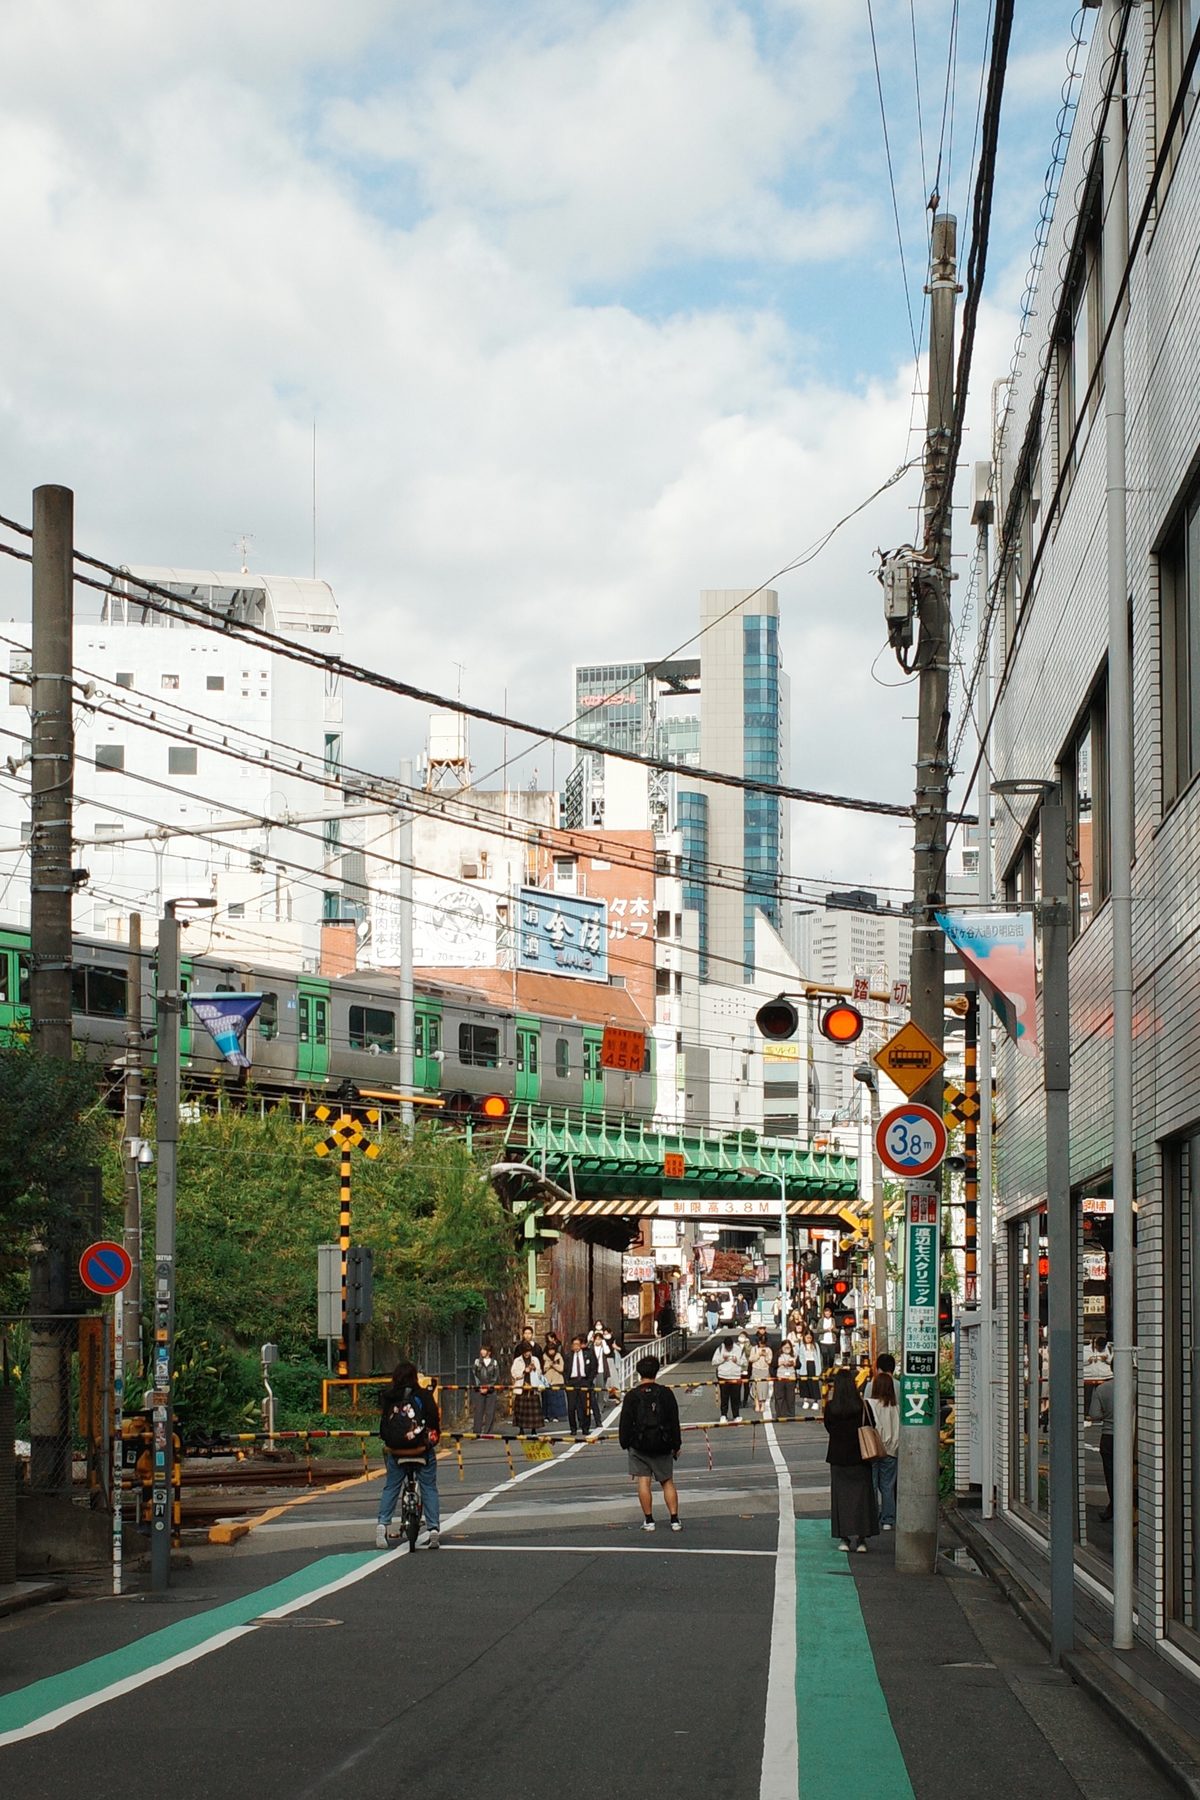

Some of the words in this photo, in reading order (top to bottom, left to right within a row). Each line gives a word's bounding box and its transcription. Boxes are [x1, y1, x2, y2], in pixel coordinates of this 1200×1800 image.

[376, 947, 423, 959] ビスロ
[890, 1124, 933, 1156] 3.8m
